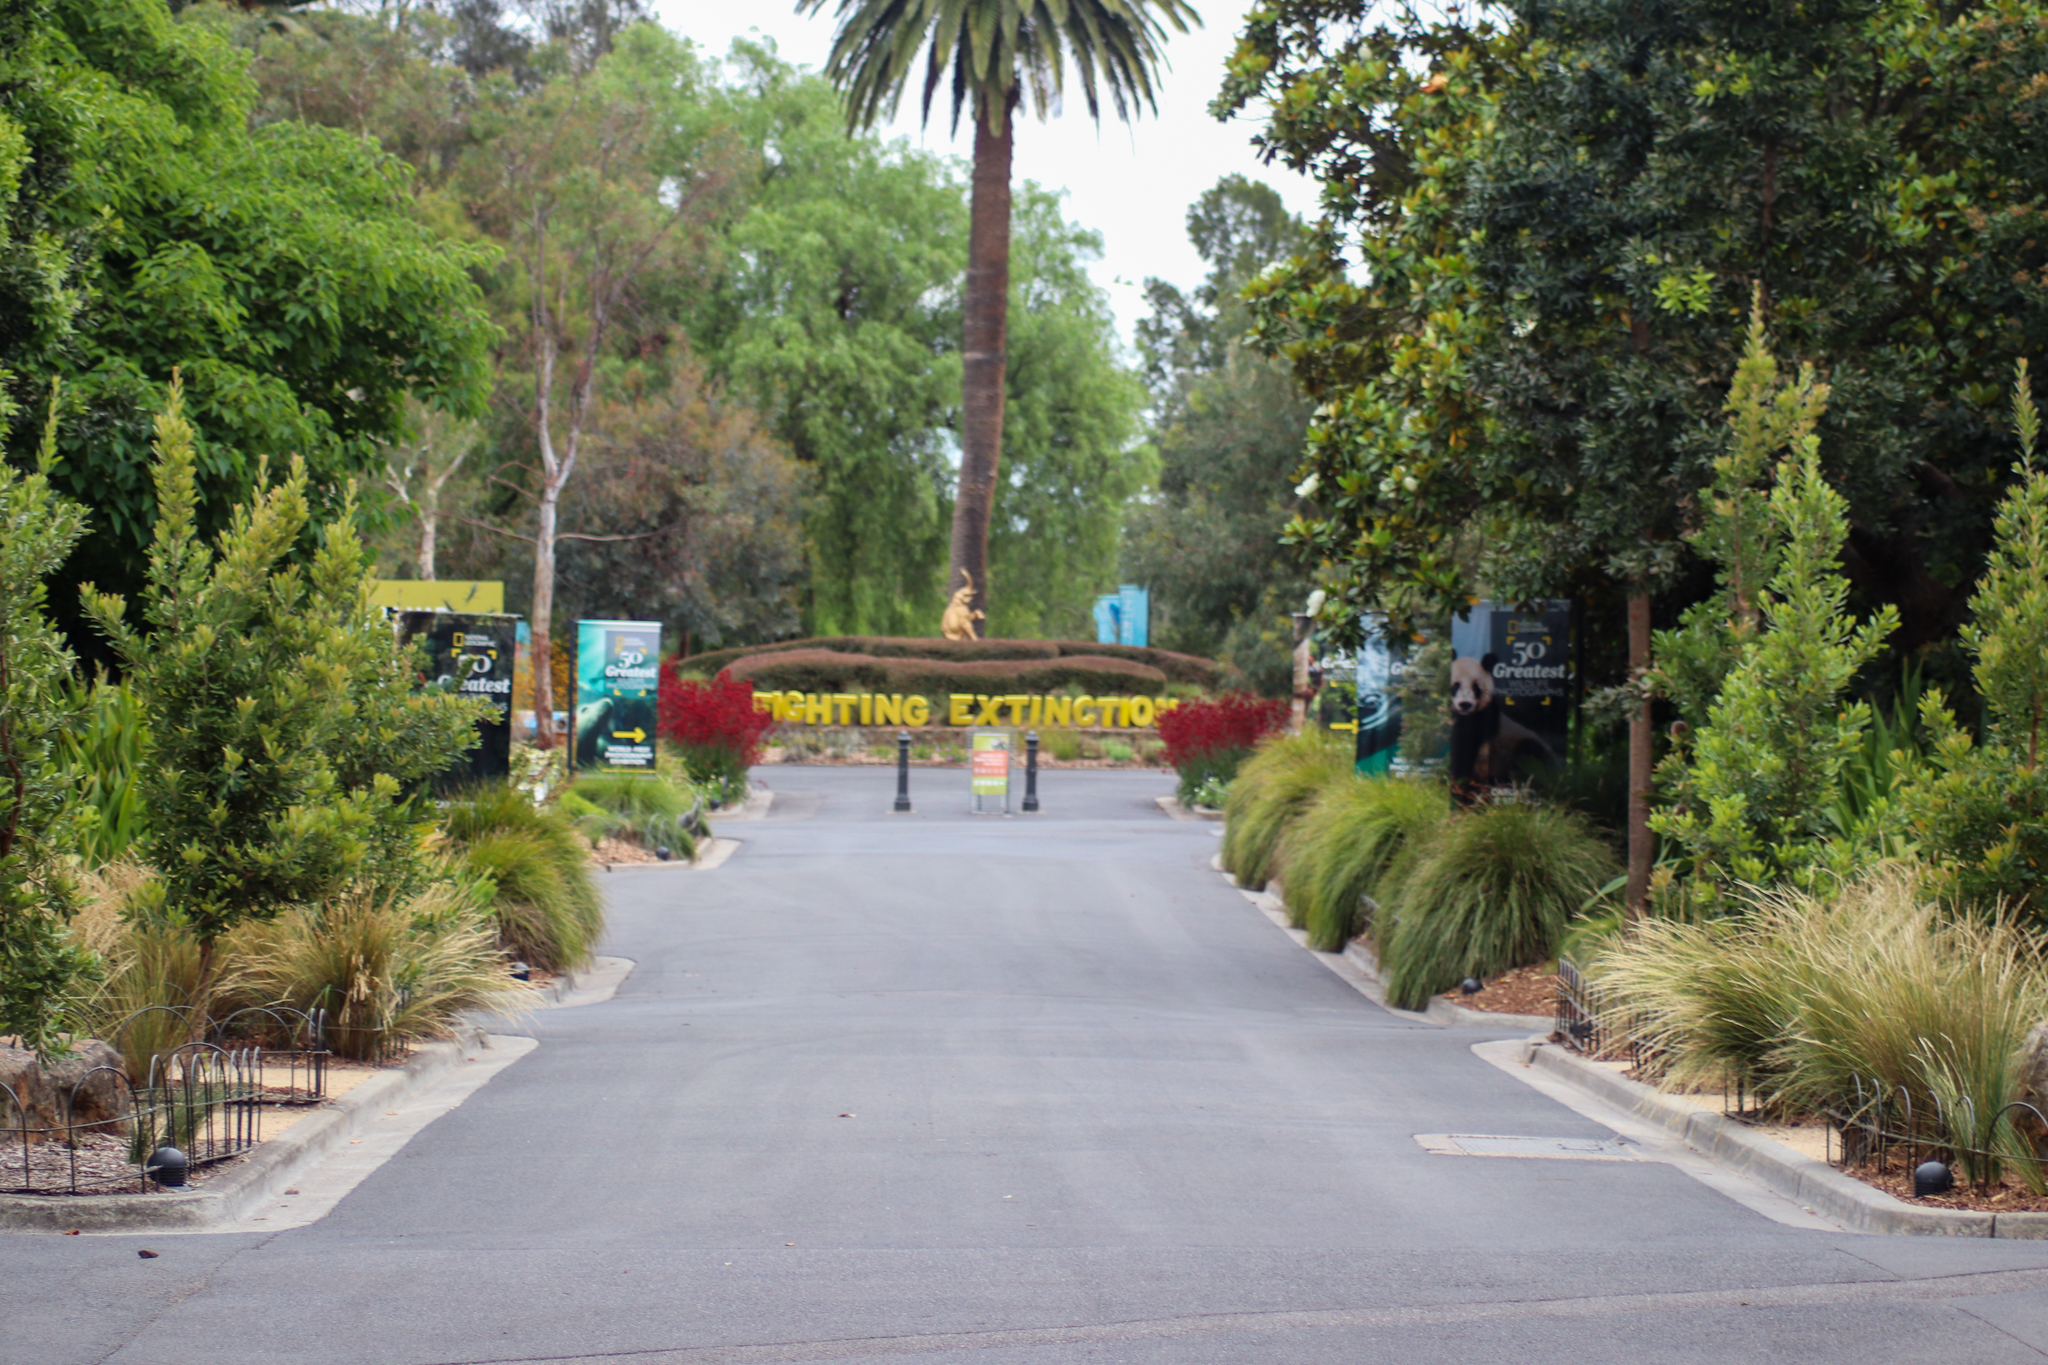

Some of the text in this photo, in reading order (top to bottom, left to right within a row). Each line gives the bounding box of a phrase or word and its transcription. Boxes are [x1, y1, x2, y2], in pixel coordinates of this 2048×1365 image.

[618, 651, 643, 668] 50
[1511, 641, 1546, 666] 50
[605, 664, 657, 678] Greatest
[1492, 662, 1566, 678] Greatest
[437, 674, 511, 693] eatest
[752, 690, 930, 727] FIGHTING
